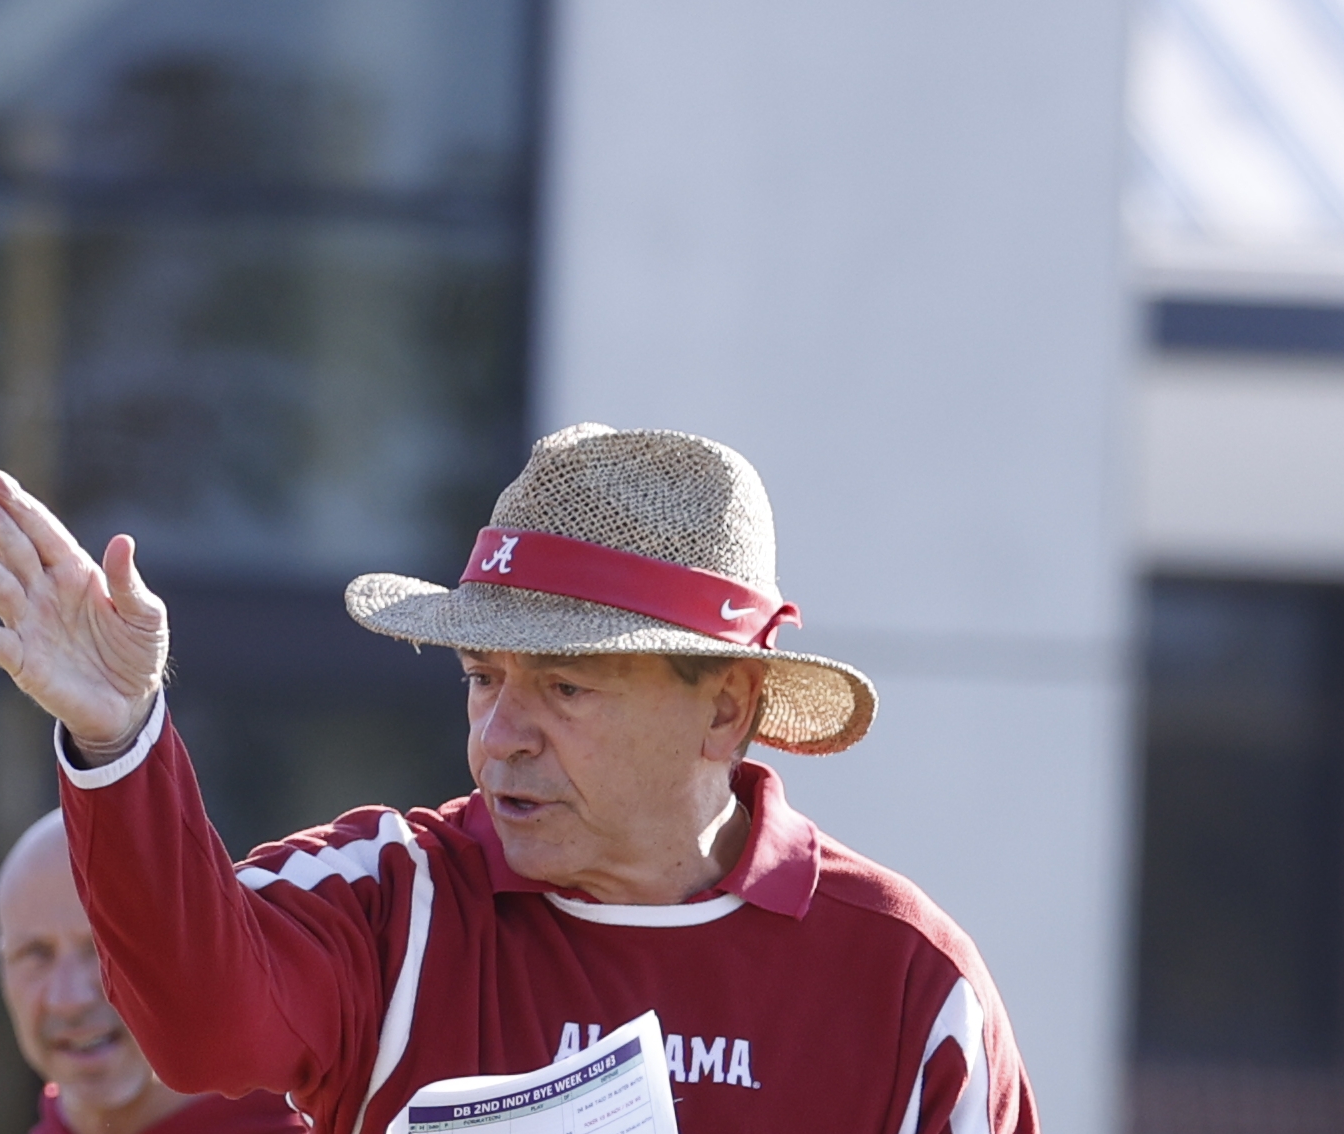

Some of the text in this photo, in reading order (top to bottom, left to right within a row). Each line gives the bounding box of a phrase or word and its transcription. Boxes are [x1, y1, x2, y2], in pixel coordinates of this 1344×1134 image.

[481, 534, 519, 575] A
[453, 1106, 471, 1118] DB
[474, 1101, 499, 1115] 2ND
[503, 1092, 531, 1108] INDY
[533, 1084, 553, 1101] BYE
[554, 1072, 583, 1093] WEEK
[588, 1060, 605, 1078] LSU
[605, 1054, 617, 1069] #3
[463, 1114, 501, 1126] FORMATION
